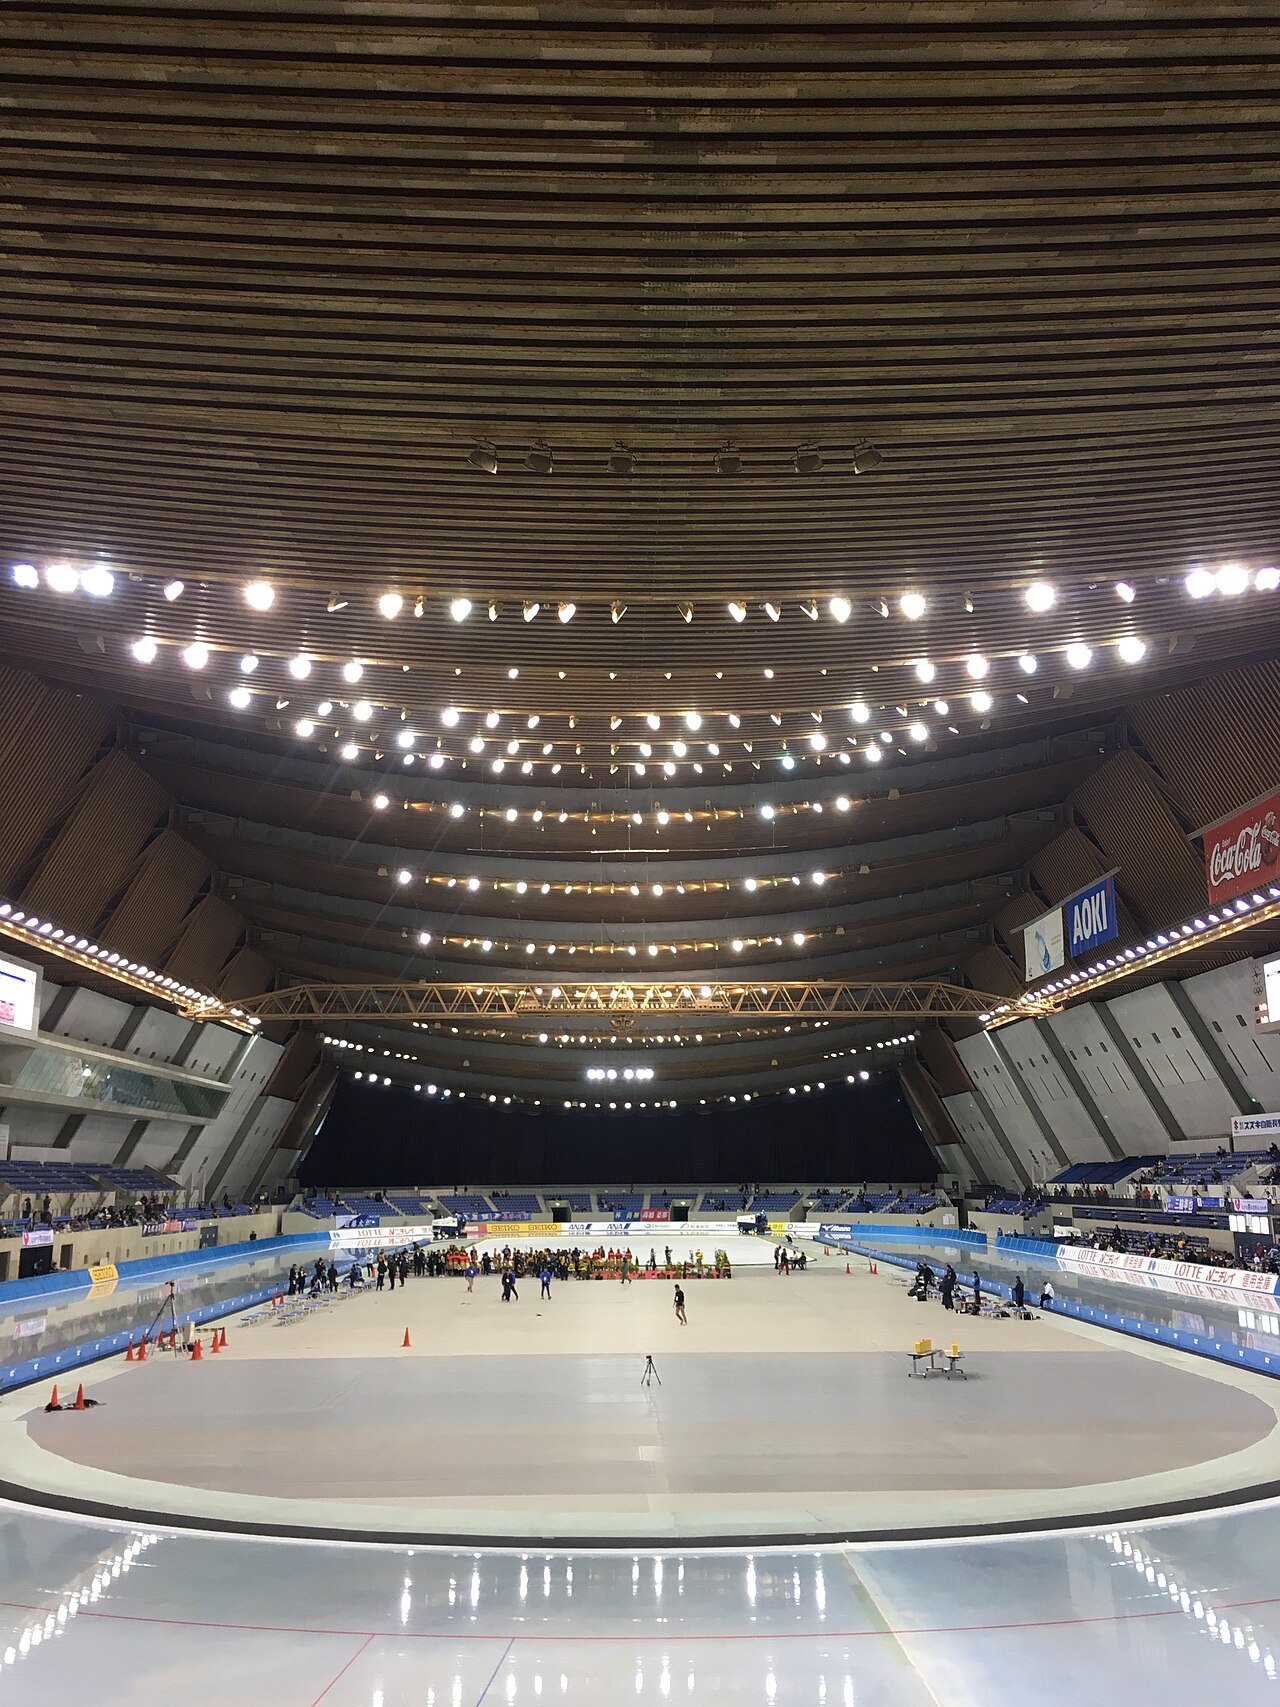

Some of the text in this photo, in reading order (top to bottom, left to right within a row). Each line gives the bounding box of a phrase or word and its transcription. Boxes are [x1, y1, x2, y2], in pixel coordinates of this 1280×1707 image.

[1210, 821, 1262, 887] Coca-Cola
[1073, 890, 1108, 945] AOKI
[358, 1229, 383, 1237] LOTTE
[1077, 1249, 1098, 1262] LOTTE
[1174, 1263, 1203, 1279] LOTTE
